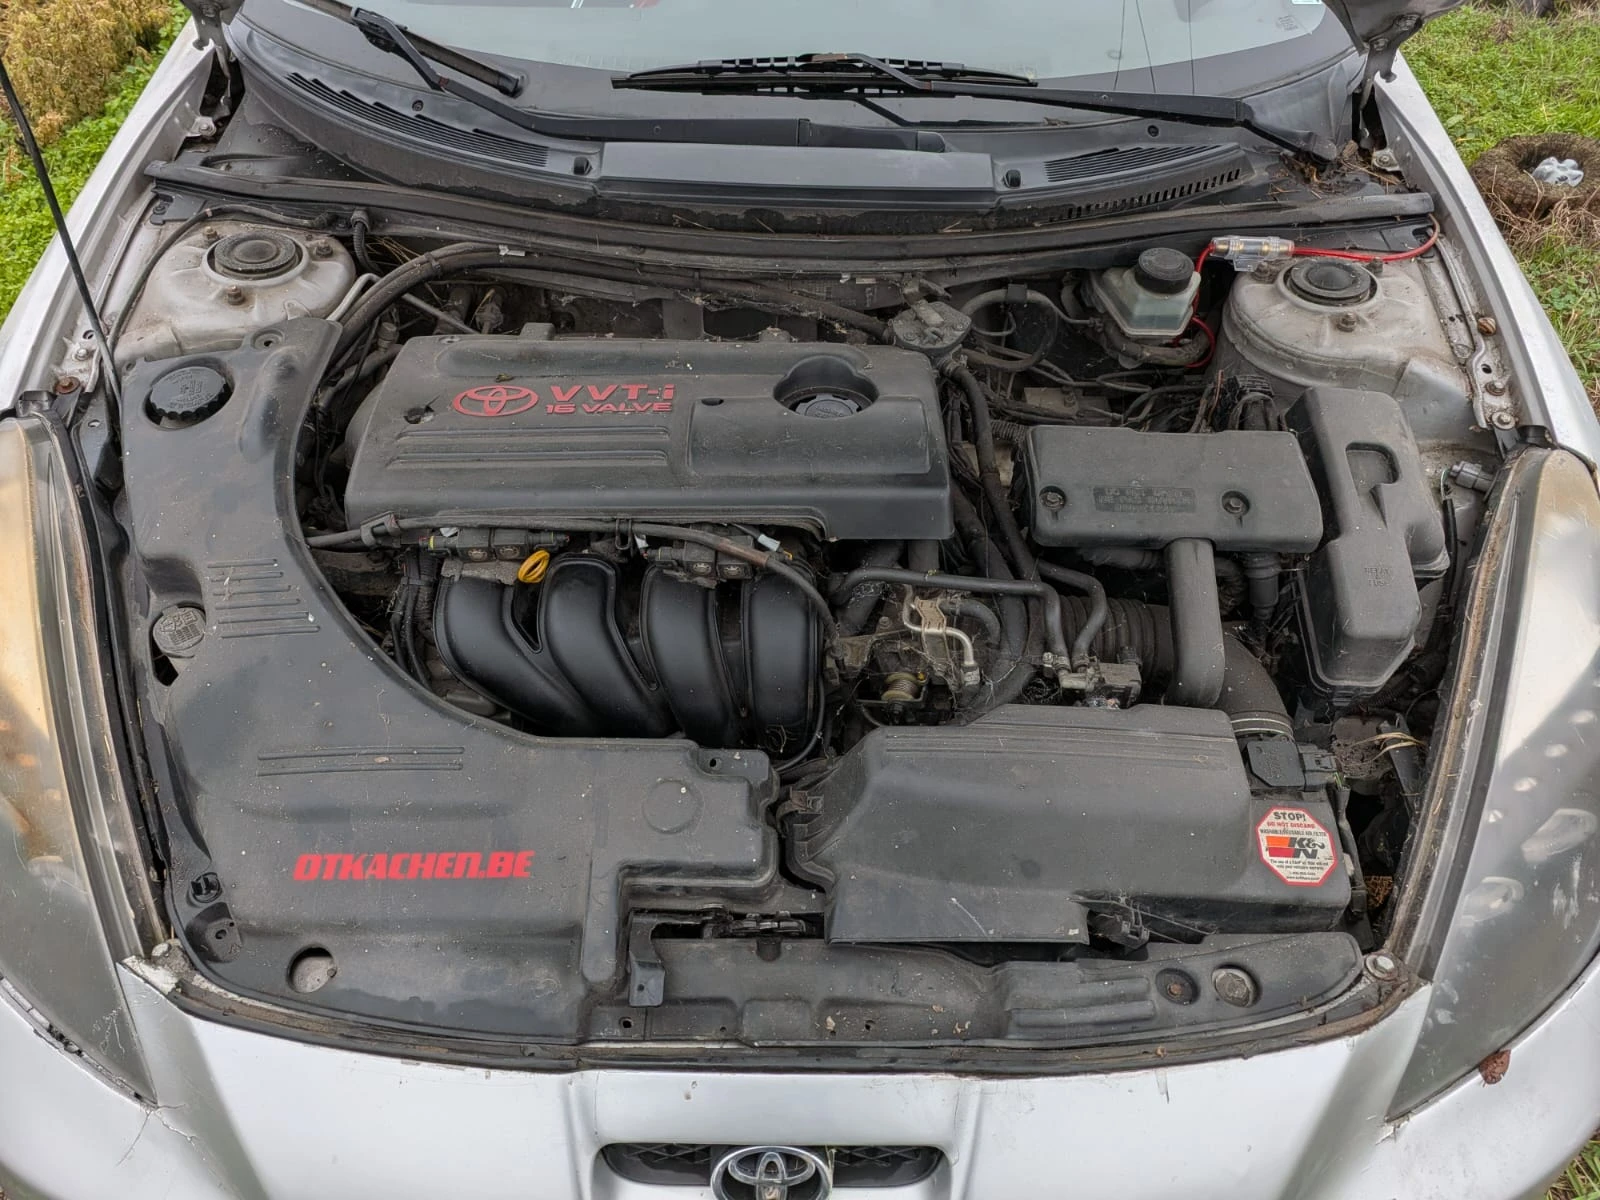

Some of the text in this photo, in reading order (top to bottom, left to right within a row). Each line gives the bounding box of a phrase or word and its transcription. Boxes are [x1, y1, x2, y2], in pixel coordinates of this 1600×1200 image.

[550, 384, 675, 402] VVT-i
[545, 402, 672, 414] 16 VALVE
[1273, 811, 1306, 821] STOP!
[1288, 837, 1325, 859] K&N
[293, 850, 535, 881] OTKACHEN.BE
